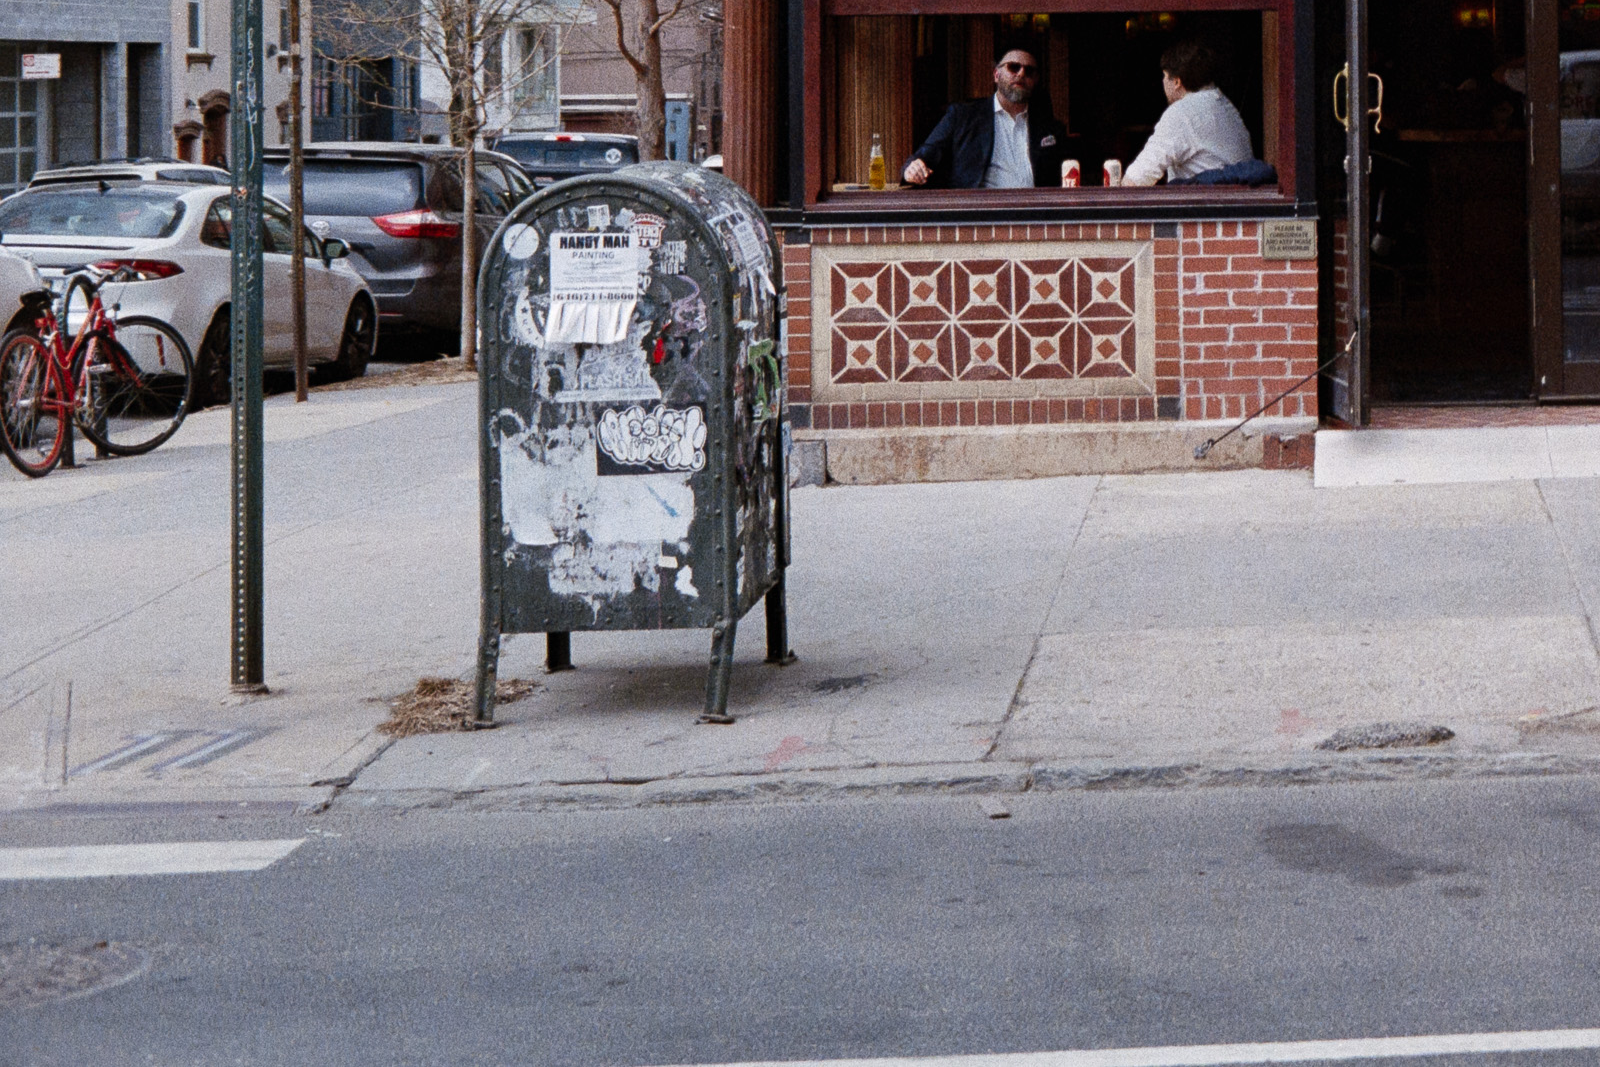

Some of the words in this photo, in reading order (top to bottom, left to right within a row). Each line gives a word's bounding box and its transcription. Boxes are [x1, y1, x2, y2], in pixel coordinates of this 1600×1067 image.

[560, 236, 600, 249] HANDY
[603, 235, 629, 249] MAN
[572, 251, 615, 259] PAINTING
